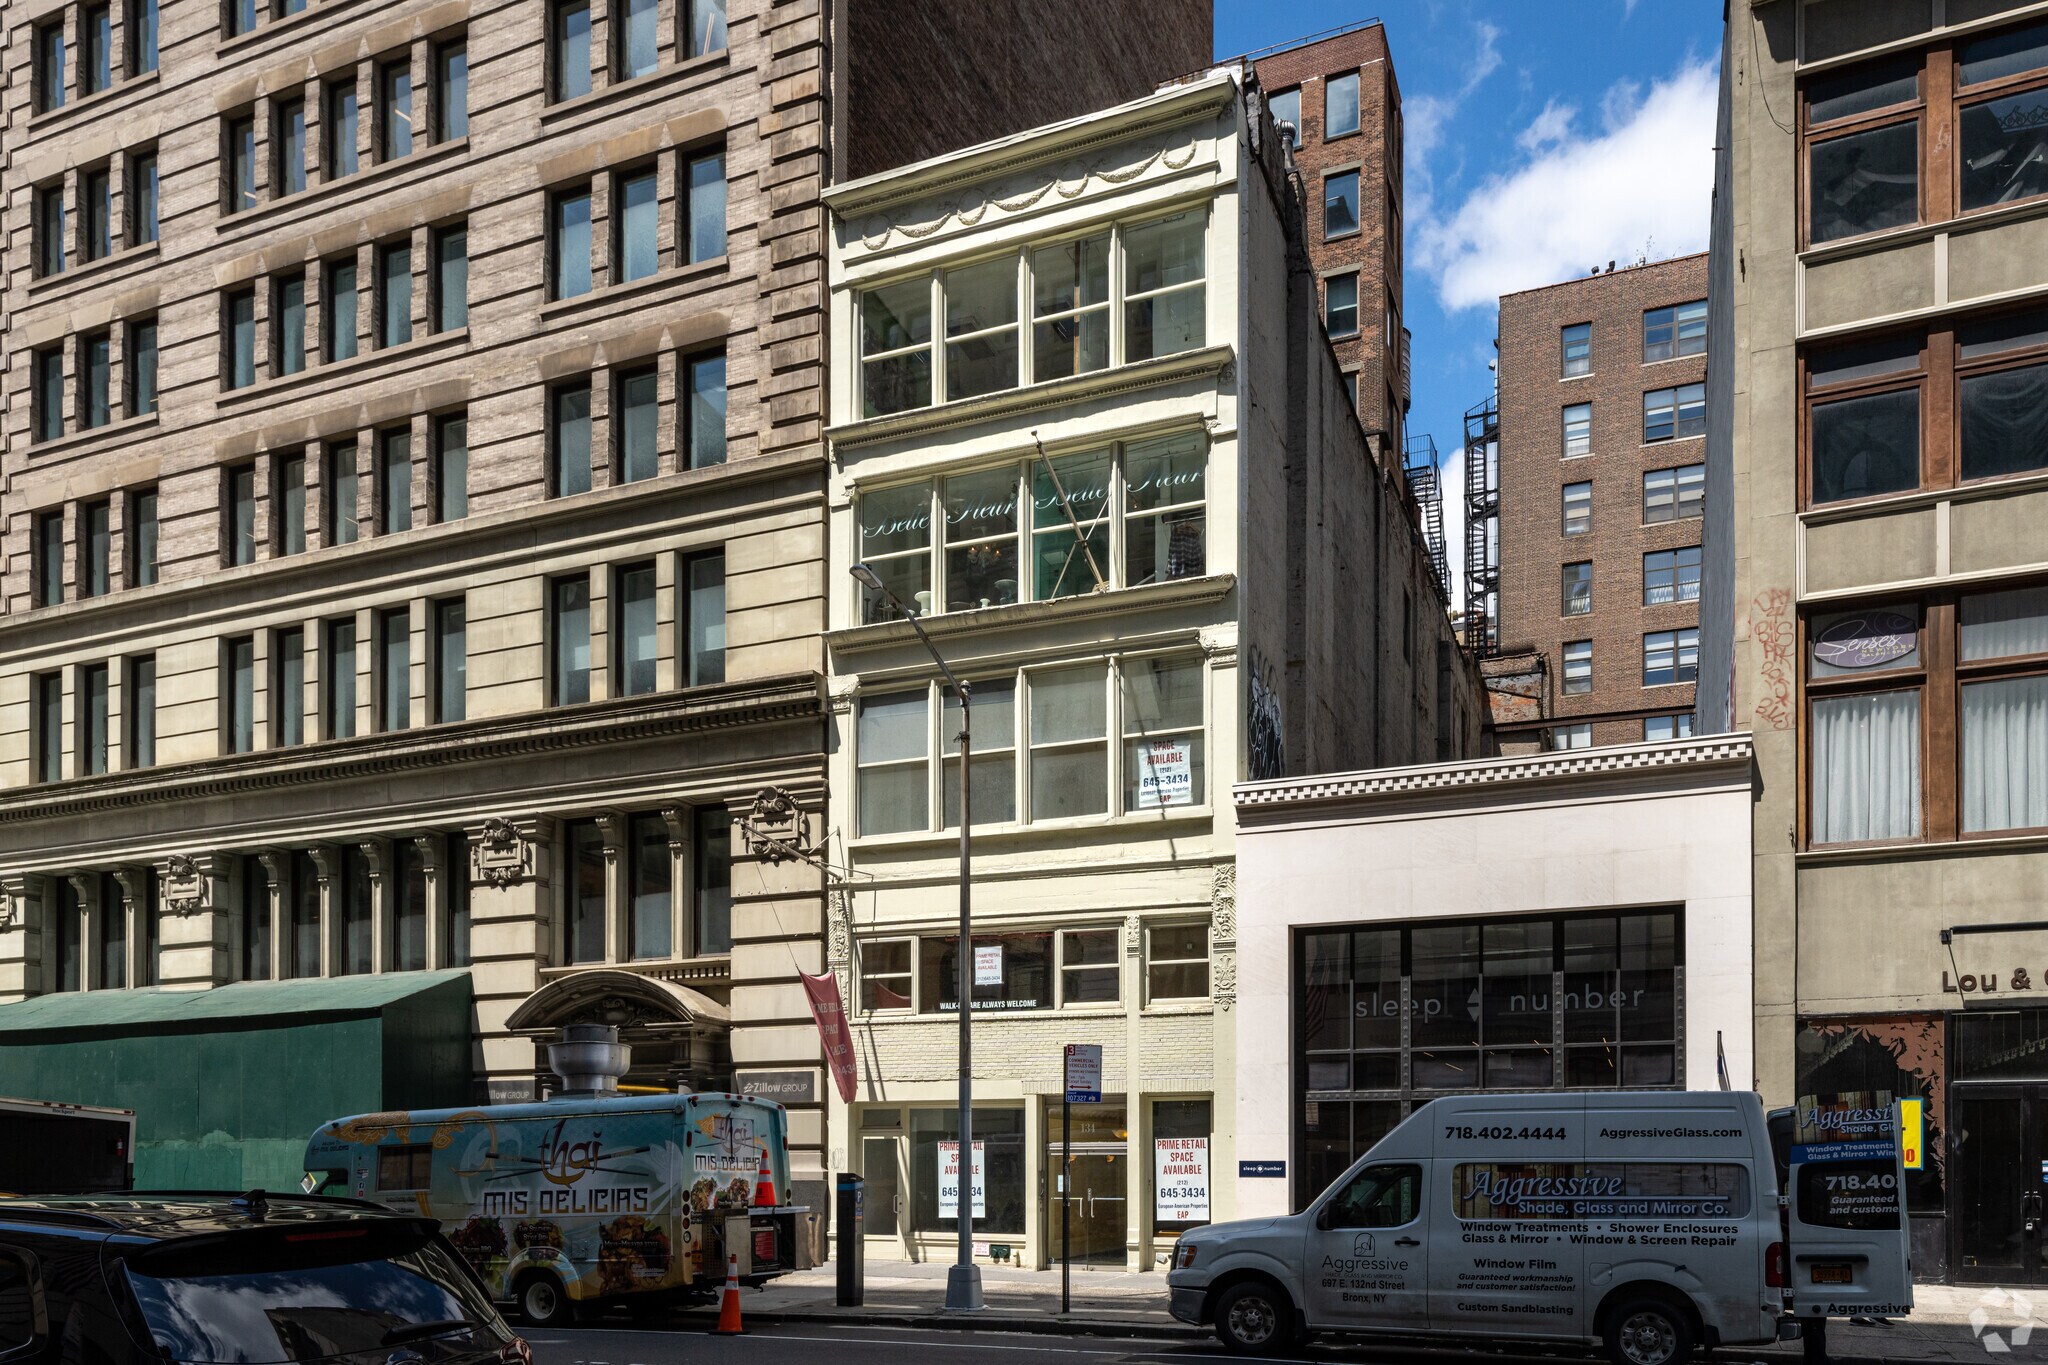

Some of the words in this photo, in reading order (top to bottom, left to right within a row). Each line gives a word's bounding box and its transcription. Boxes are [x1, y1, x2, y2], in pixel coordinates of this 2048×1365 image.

[1814, 619, 1901, 657] Senses
[1153, 740, 1175, 752] SPACE
[1147, 752, 1183, 766] AVAILABLE
[1143, 774, 1189, 787] 645-3434
[1159, 795, 1171, 803] EAP
[1942, 971, 1997, 993] Lou
[2011, 967, 2032, 991] &
[982, 1000, 1005, 1008] ALWAYS
[1006, 1000, 1037, 1008] WELCOME
[1354, 991, 1442, 1024] sleep
[1068, 1045, 1075, 1055] 3
[753, 1082, 780, 1093] Zillow
[781, 1083, 808, 1094] GROUP
[507, 1091, 530, 1100] GROUP
[1081, 1123, 1095, 1133] 134
[1445, 1126, 1567, 1140] 718.402.4444
[1600, 1127, 1742, 1139] AggressiveGlass.com
[1841, 1124, 1877, 1133] Shade,
[939, 1141, 959, 1151] PRIME
[1157, 1140, 1180, 1149] PRIME
[1181, 1139, 1206, 1149] RETAIL
[1806, 1145, 1842, 1153] Window
[1844, 1143, 1894, 1151] Treatments
[538, 1118, 603, 1189] thai
[1170, 1152, 1194, 1162] SPACE
[695, 1155, 717, 1170] MIS
[1163, 1165, 1202, 1174] AVAILABLE
[1463, 1170, 1626, 1205] Aggressive
[483, 1190, 529, 1215] MIS
[539, 1187, 649, 1215] DELICIAS
[1831, 1195, 1895, 1204] Guaranteed
[1177, 1210, 1189, 1219] EAP
[1518, 1201, 1569, 1216] Shade,
[1573, 1201, 1614, 1215] Glass
[1618, 1202, 1647, 1215] and
[1652, 1202, 1698, 1215] Mirror
[1701, 1202, 1729, 1215] Co.
[1829, 1206, 1850, 1214] and
[1460, 1222, 1513, 1233] Window
[1515, 1222, 1589, 1233] Treatments
[1609, 1223, 1661, 1234] Shower
[1663, 1223, 1739, 1234] Enclosures
[1462, 1233, 1496, 1245] Glass
[1498, 1234, 1507, 1244] &
[1510, 1234, 1549, 1245] Mirror
[1569, 1234, 1624, 1245] Window
[1627, 1235, 1637, 1245] &
[1640, 1235, 1687, 1246] Screen
[1690, 1235, 1737, 1247] Repair
[1321, 1255, 1409, 1273] Aggressive
[1473, 1258, 1526, 1270] Window
[1529, 1259, 1557, 1270] Film
[1458, 1272, 1511, 1282] Guaranteed
[1512, 1273, 1574, 1284] workmanship
[1321, 1279, 1337, 1287] 697
[1339, 1280, 1348, 1288] E.
[1351, 1280, 1377, 1289] 132nd
[1378, 1281, 1405, 1290] Street
[1456, 1281, 1471, 1291] and
[1472, 1282, 1516, 1291] customer
[1518, 1282, 1576, 1292] satisfaction!
[1342, 1293, 1371, 1303] Bronx,
[1373, 1294, 1387, 1303] NY
[1457, 1302, 1498, 1313] Custom
[1501, 1303, 1574, 1316] Sandblasting
[1827, 1302, 1910, 1315] Aggressive
